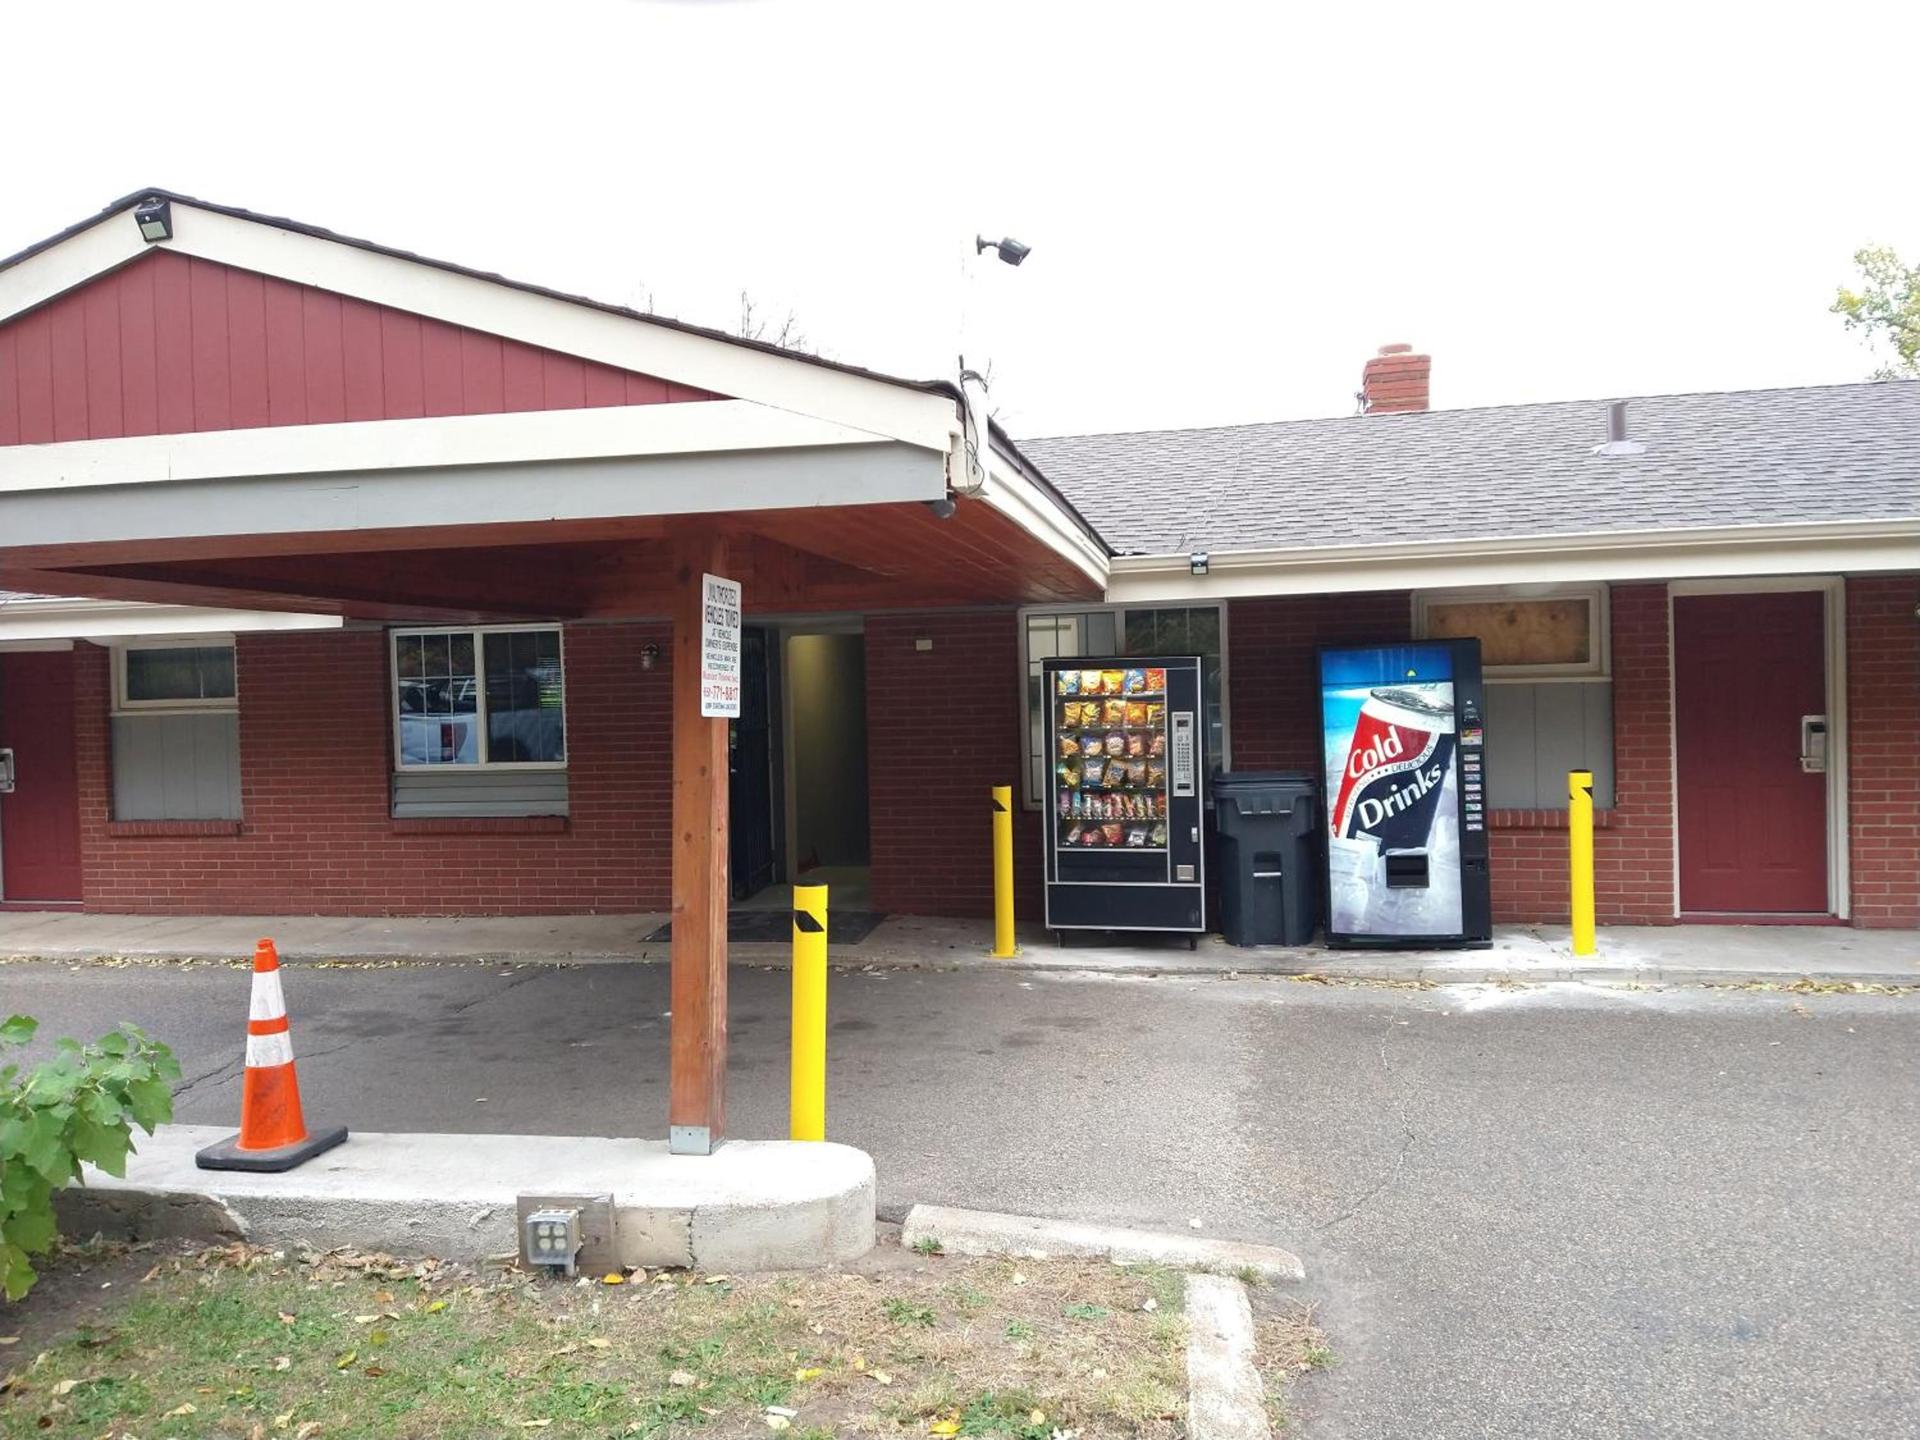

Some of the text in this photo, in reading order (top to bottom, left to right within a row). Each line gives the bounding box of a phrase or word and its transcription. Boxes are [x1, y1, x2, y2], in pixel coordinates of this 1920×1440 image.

[1349, 725, 1403, 778] Cold
[1391, 744, 1433, 772] DELICIOUS
[1358, 764, 1441, 829] Drinks
